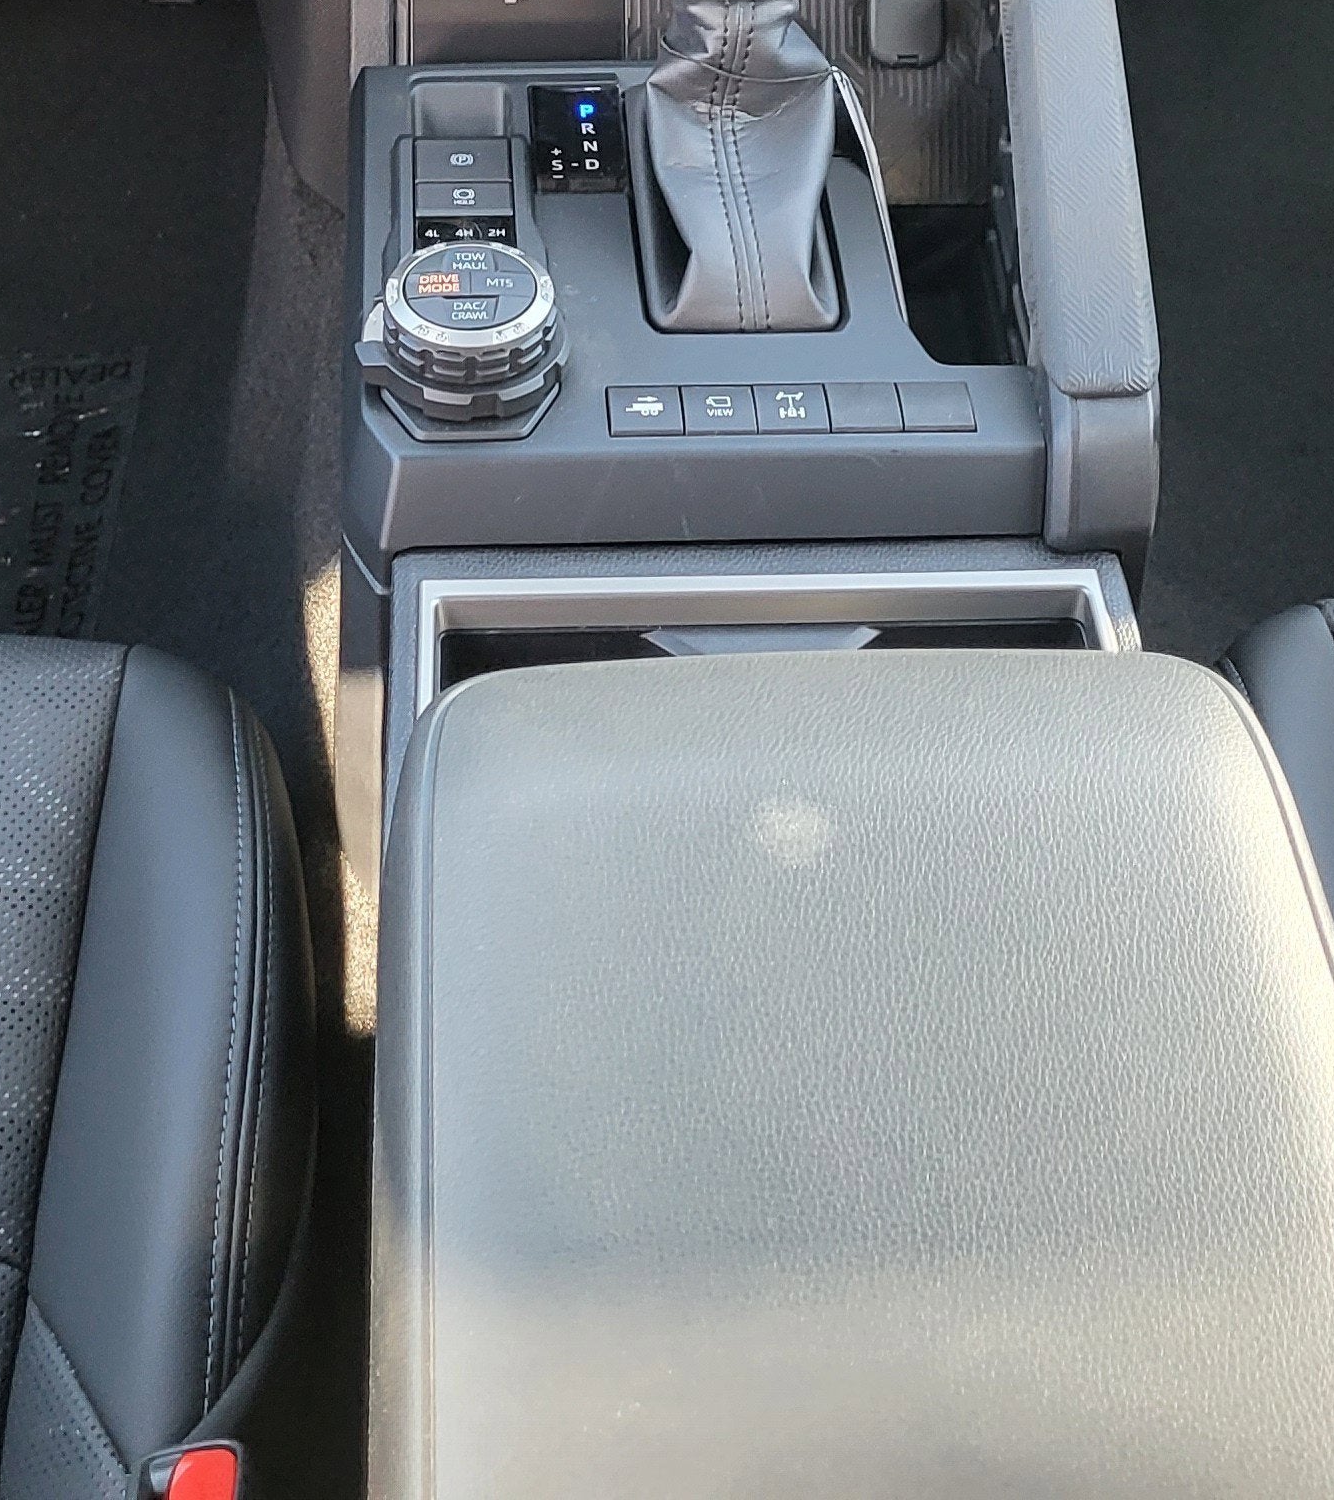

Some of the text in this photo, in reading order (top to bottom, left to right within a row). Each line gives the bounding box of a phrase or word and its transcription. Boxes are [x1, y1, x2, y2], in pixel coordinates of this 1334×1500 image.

[579, 104, 595, 119] P
[581, 122, 596, 135] R
[583, 140, 599, 152] N
[551, 159, 564, 171] S
[585, 158, 601, 170] D
[424, 229, 440, 238] 4L
[455, 228, 474, 237] 4H
[487, 228, 506, 237] 2H
[454, 252, 486, 261] TOW
[452, 262, 488, 271] HAUL
[419, 273, 460, 284] DRIVE
[486, 277, 514, 288] MTS
[418, 283, 460, 294] MODE
[453, 301, 487, 311] DAC/
[451, 311, 489, 320] CRAWL
[707, 408, 734, 417] VIEW
